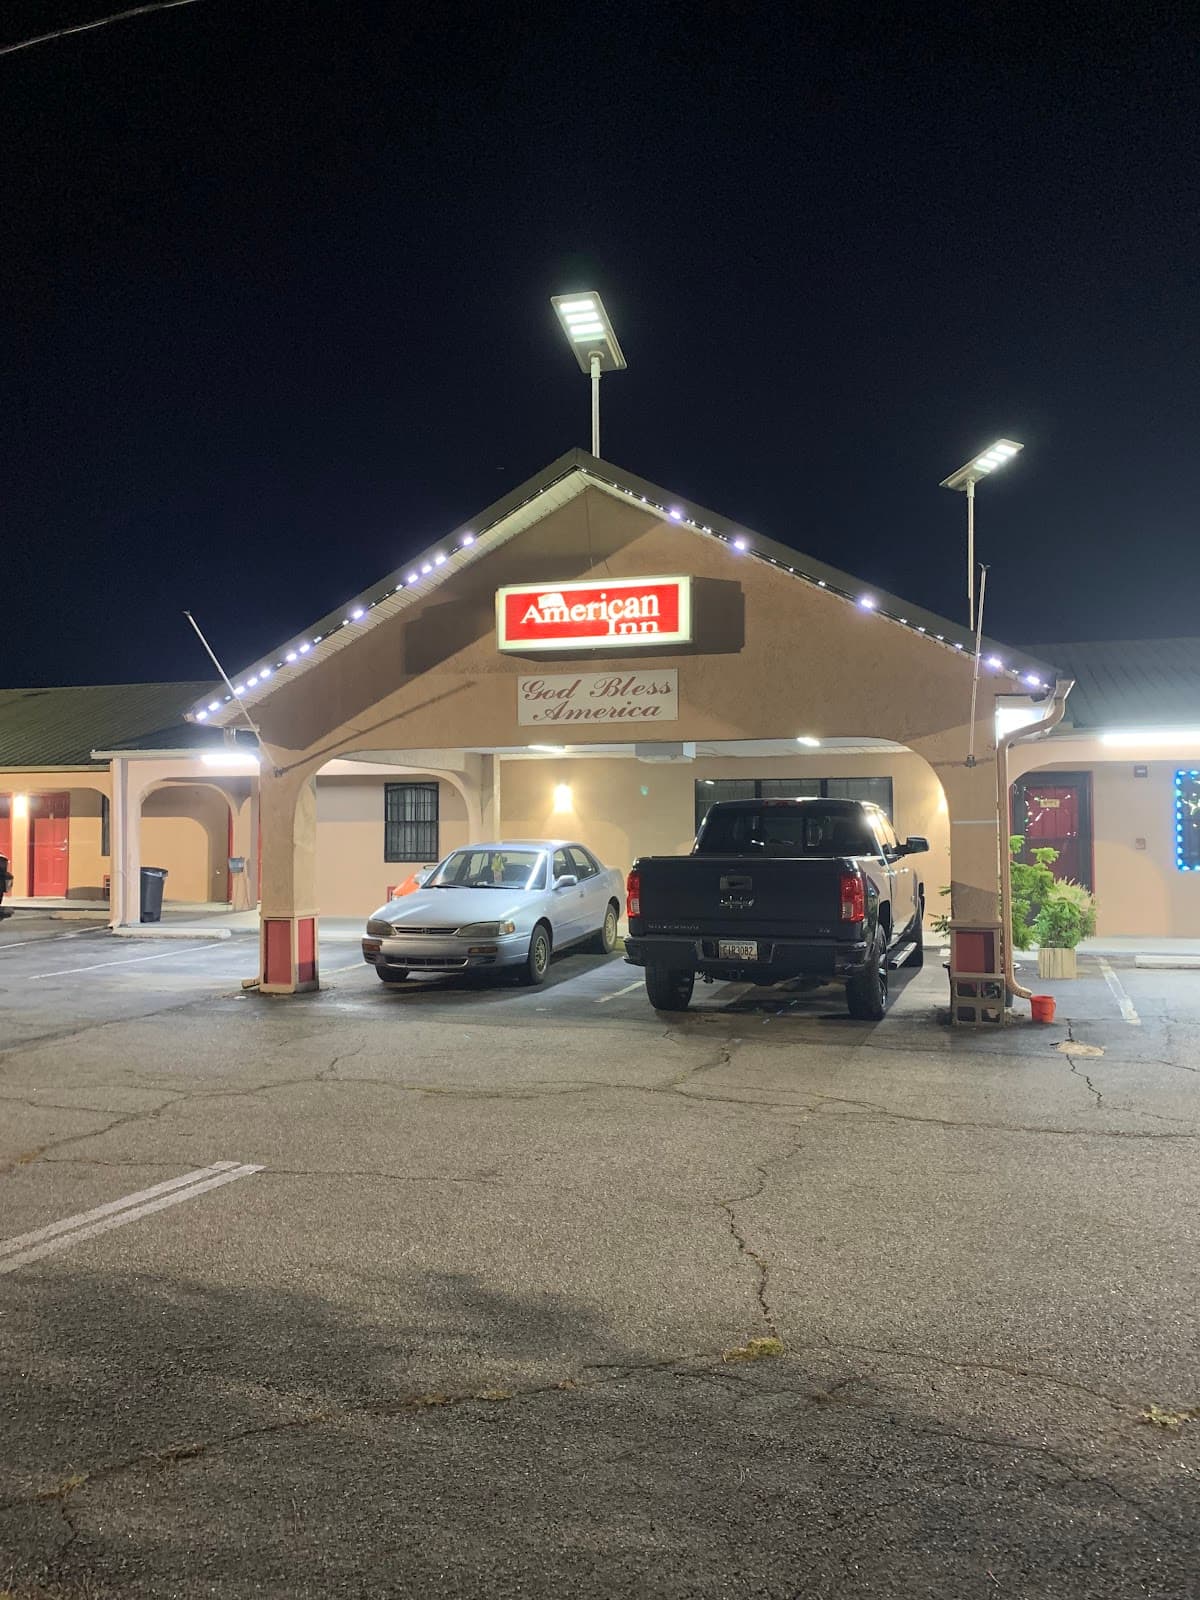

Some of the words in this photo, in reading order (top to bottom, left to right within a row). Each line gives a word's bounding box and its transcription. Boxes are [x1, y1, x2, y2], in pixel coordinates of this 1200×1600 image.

[520, 592, 661, 624] American
[606, 620, 661, 635] Inn
[522, 679, 582, 701] God
[589, 676, 674, 698] Bless
[532, 700, 662, 721] America
